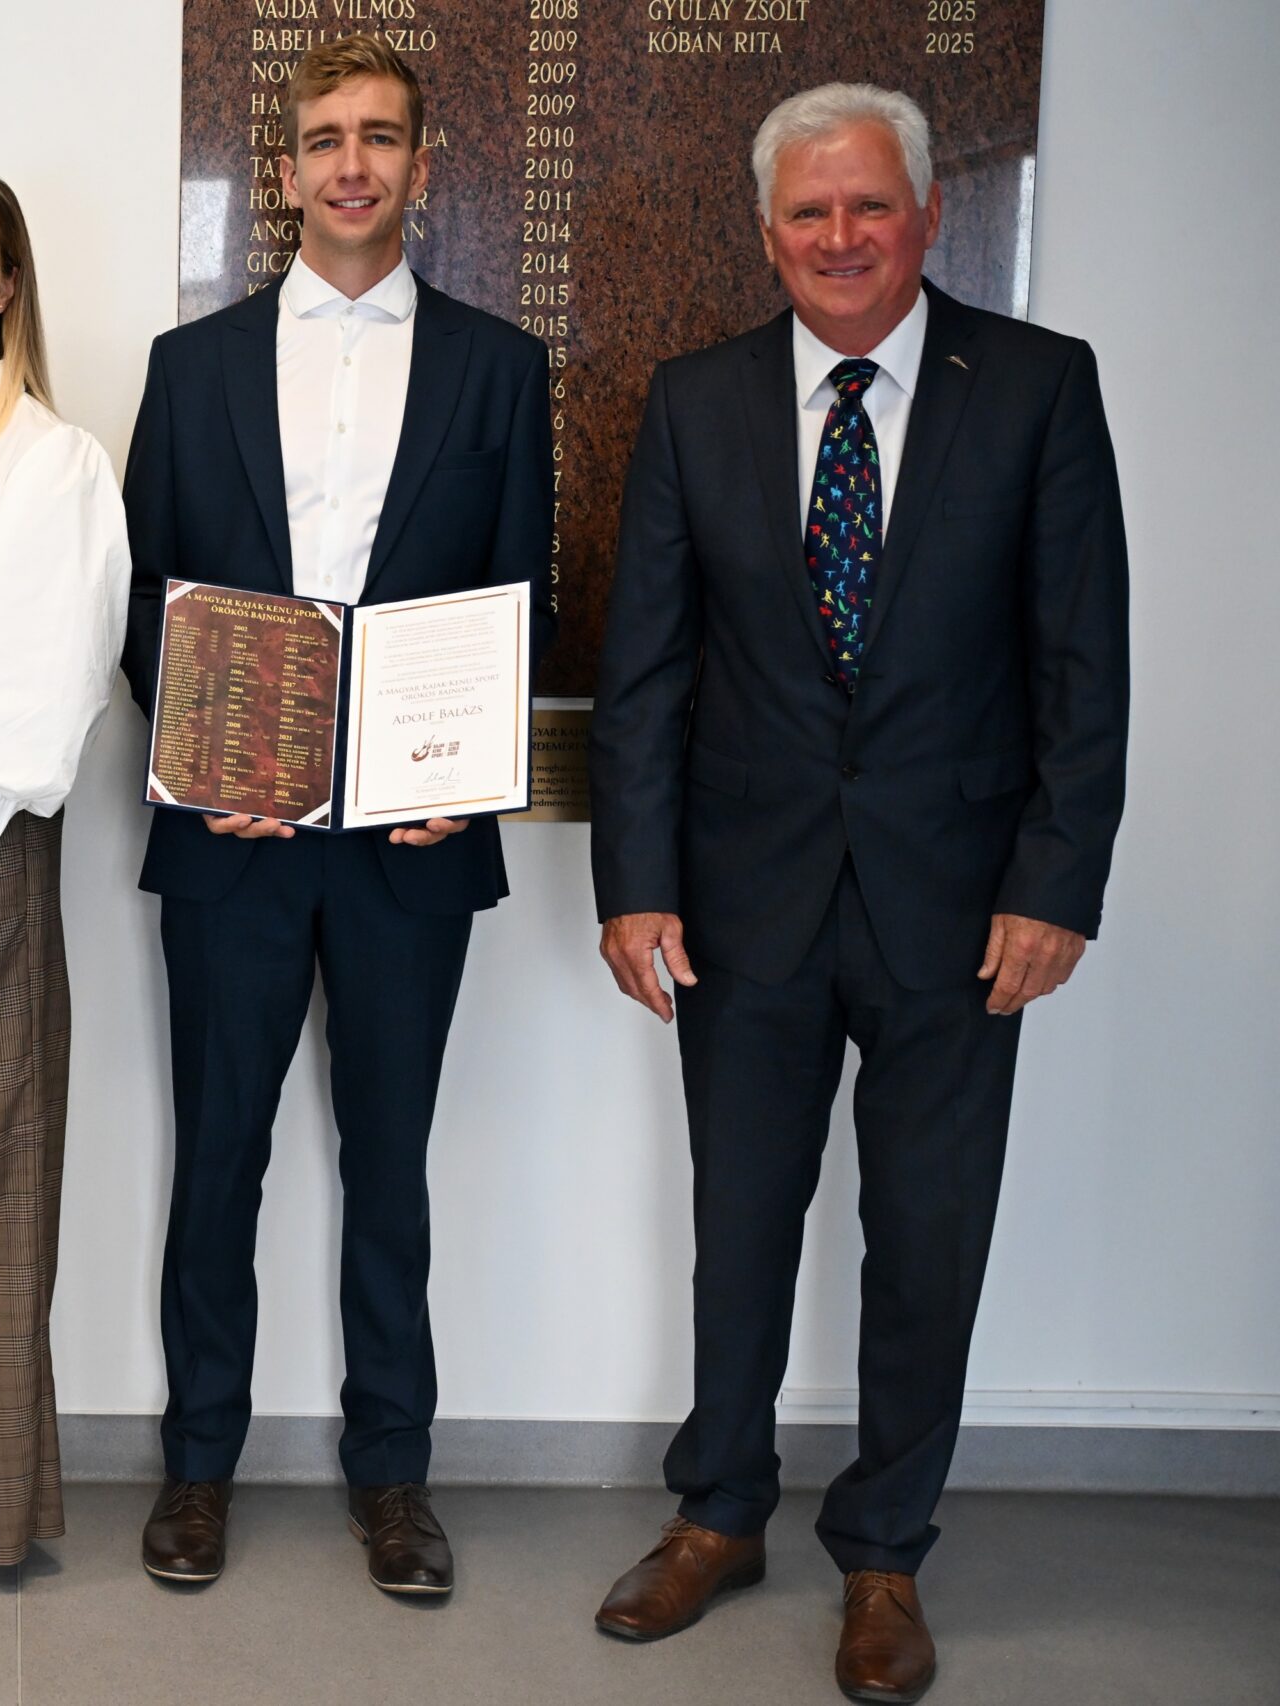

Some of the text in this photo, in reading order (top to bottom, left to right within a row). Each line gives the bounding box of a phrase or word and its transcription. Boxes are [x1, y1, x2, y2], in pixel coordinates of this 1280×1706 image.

[255, 0, 578, 19] VAJDA VILMOS 2008
[648, 0, 976, 22] GYULAY ZSOLT 2025
[529, 30, 578, 51] 2009
[648, 26, 974, 54] KŐBÁN RITA 2025
[251, 61, 577, 84] NOV 2009
[251, 93, 576, 115] HA 2009
[250, 120, 287, 146] FÜZ
[526, 126, 575, 148] 2010
[525, 158, 573, 179] 2010
[524, 189, 571, 211] 2011
[249, 220, 571, 242] ANGY 2014
[522, 252, 570, 274] 2014
[521, 284, 569, 305] 2015
[520, 315, 568, 336] 2015
[547, 347, 567, 368] 15
[194, 593, 233, 606] MAGYAR
[235, 598, 293, 615] KAJAK-KENU
[294, 608, 322, 620] SPORT
[211, 604, 297, 625] ÖRÖKÖS BAJNOKAI
[392, 711, 436, 725] ADOLF
